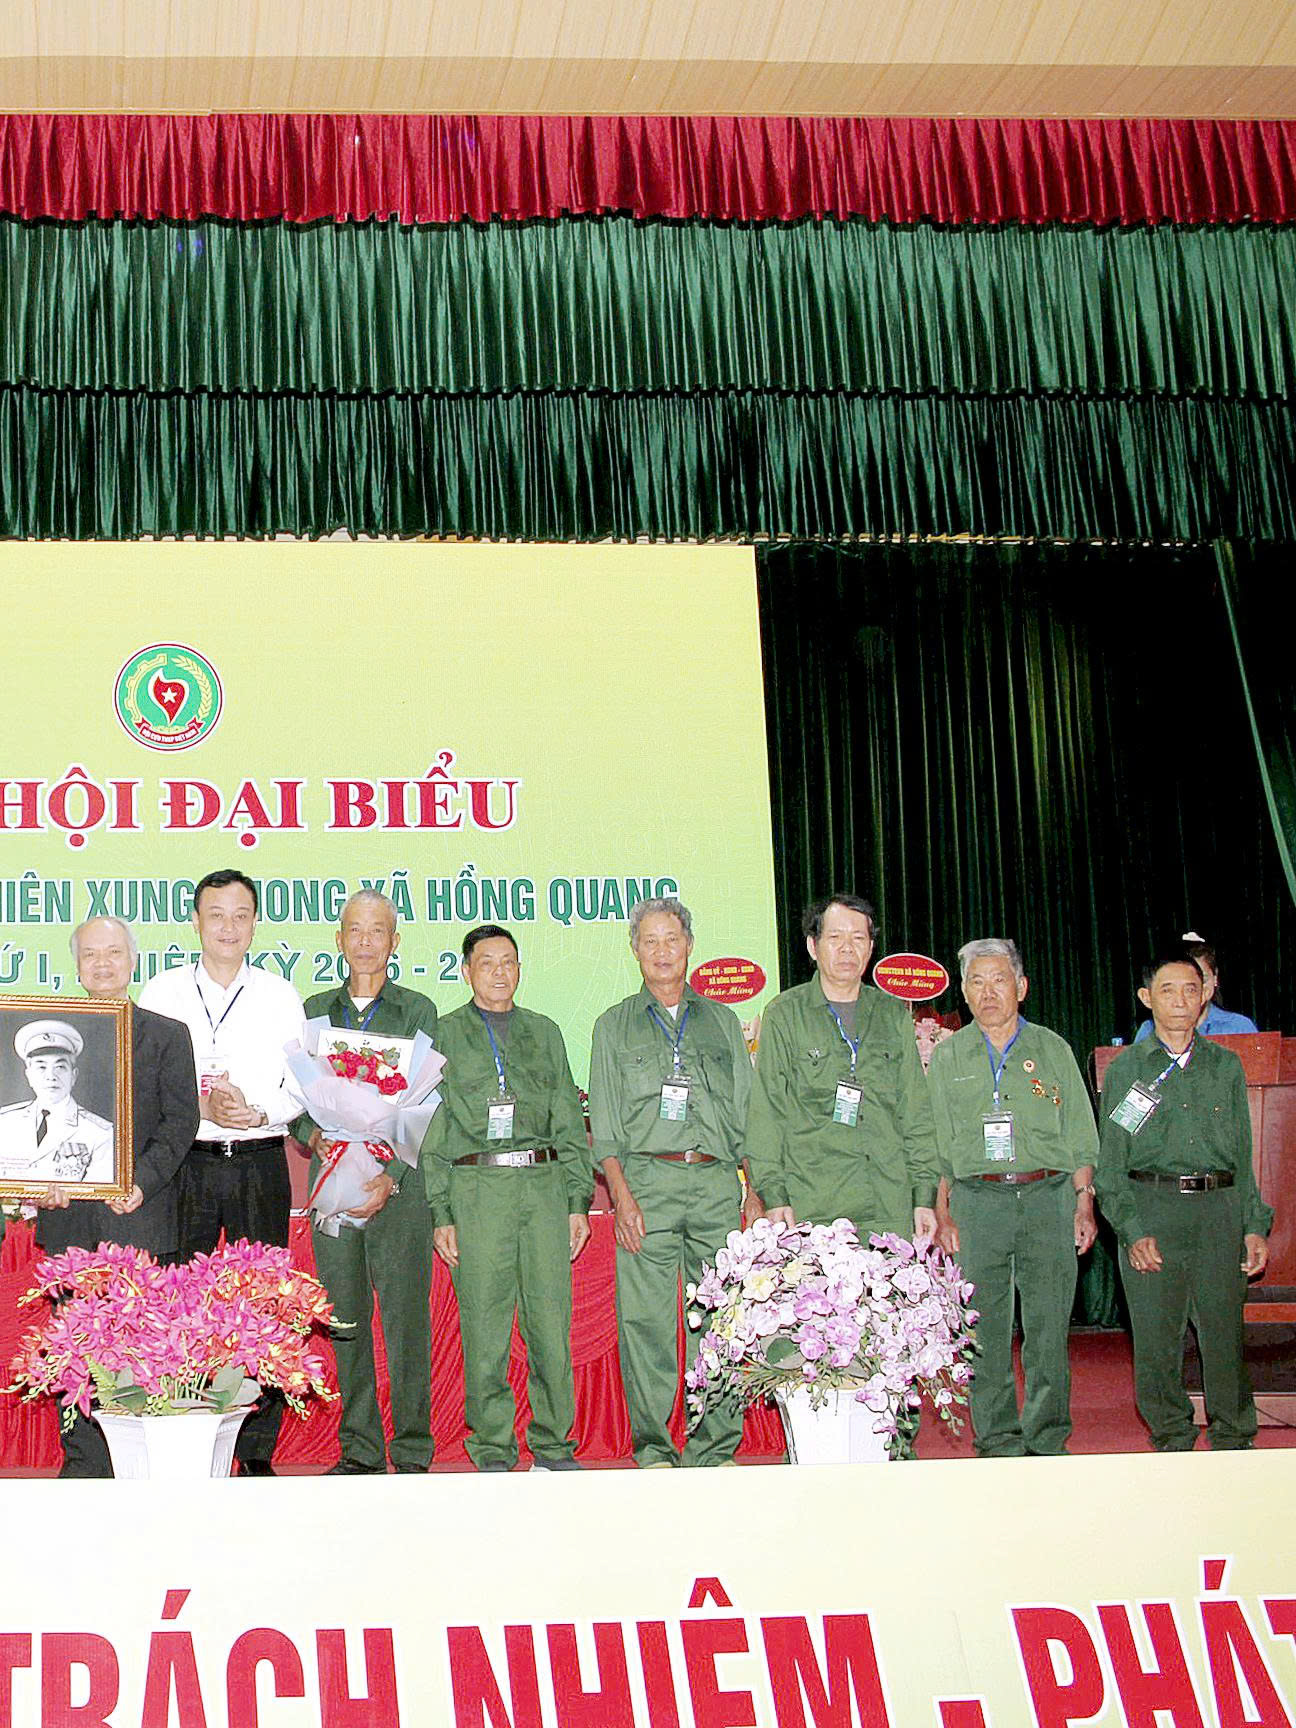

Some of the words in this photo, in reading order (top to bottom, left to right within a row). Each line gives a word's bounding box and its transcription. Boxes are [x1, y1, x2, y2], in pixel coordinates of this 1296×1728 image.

[163, 780, 304, 847] ĐẠI
[329, 752, 519, 829] BIỂU
[87, 880, 195, 922] XUNG
[428, 865, 534, 921] HỒNG
